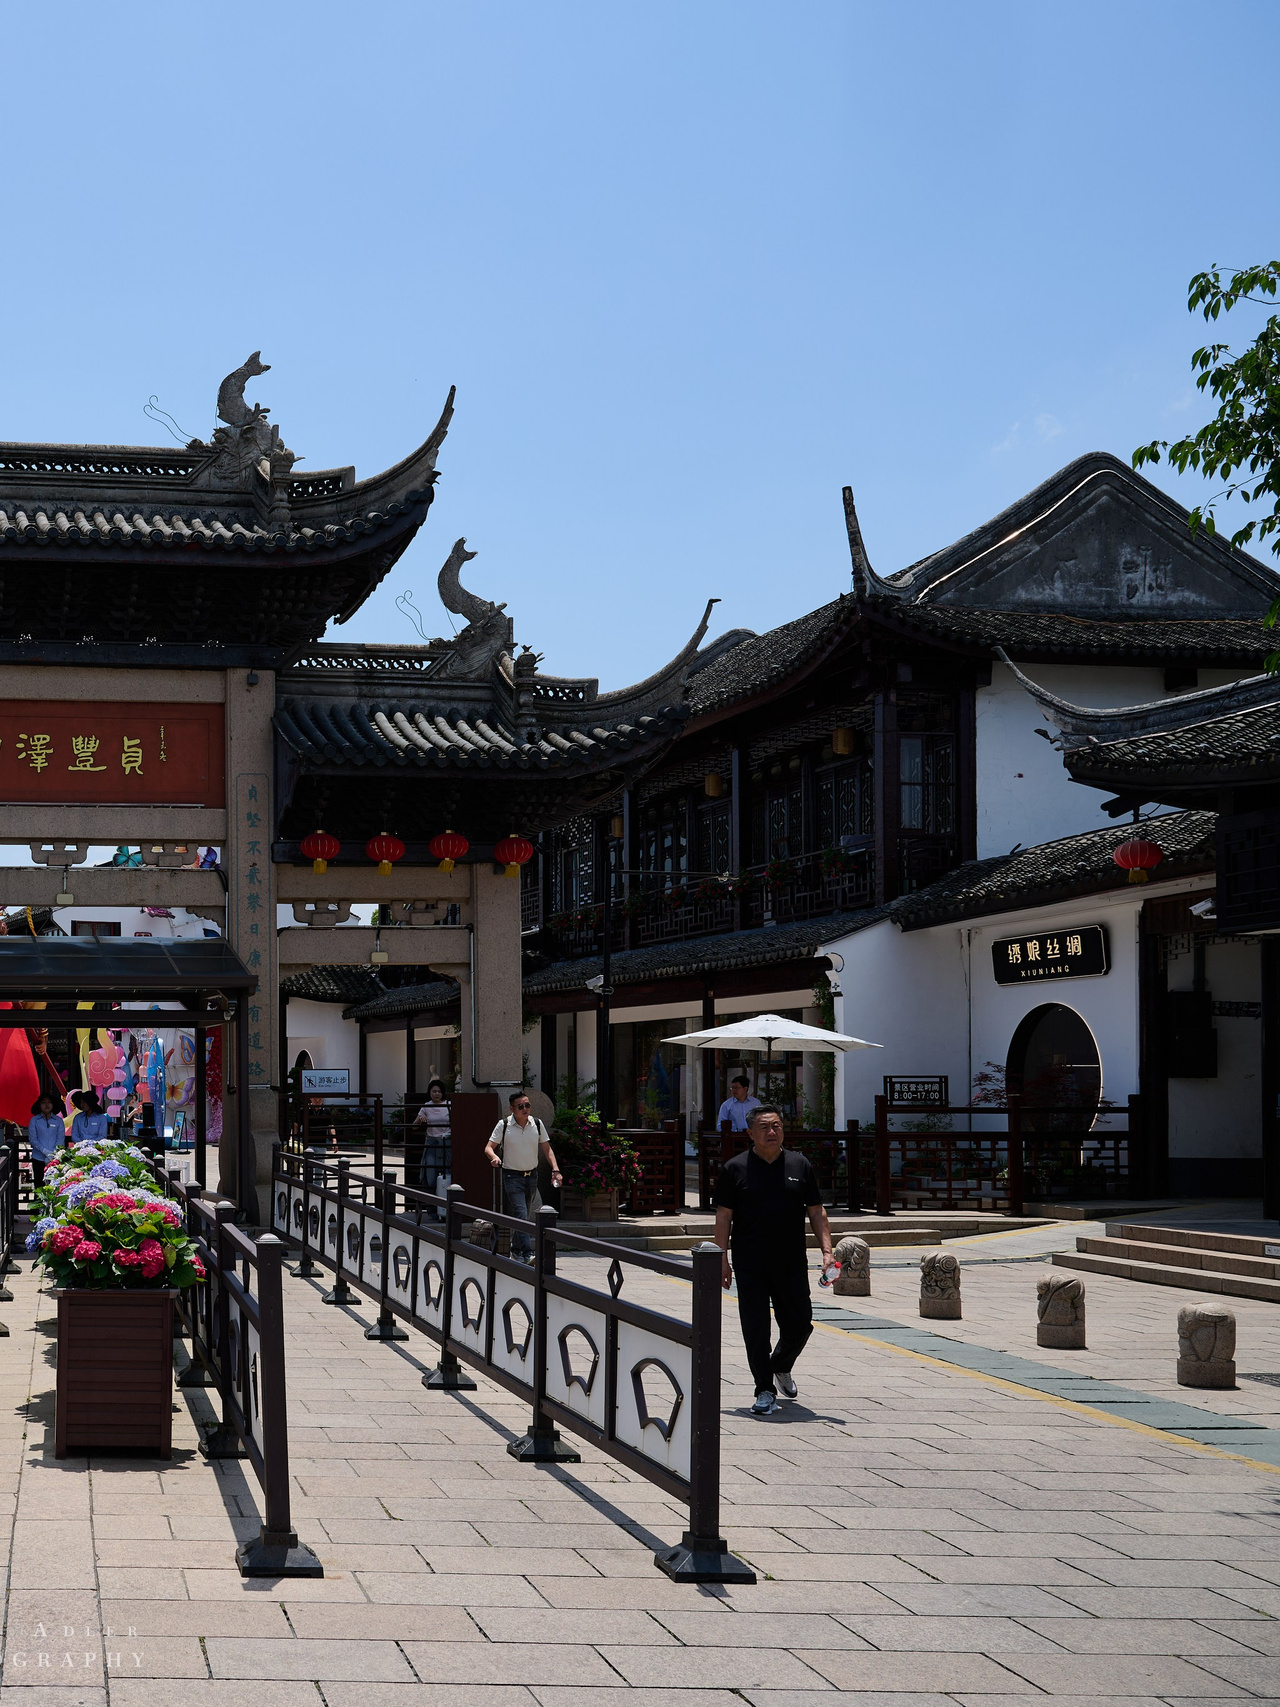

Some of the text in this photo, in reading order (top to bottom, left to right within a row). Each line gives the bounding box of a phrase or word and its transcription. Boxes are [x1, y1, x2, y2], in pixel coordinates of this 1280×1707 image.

[1007, 934, 1083, 964] 绣娘丝绸
[1021, 965, 1070, 977] XIUNIANG
[894, 1083, 940, 1092] 景区营业时间
